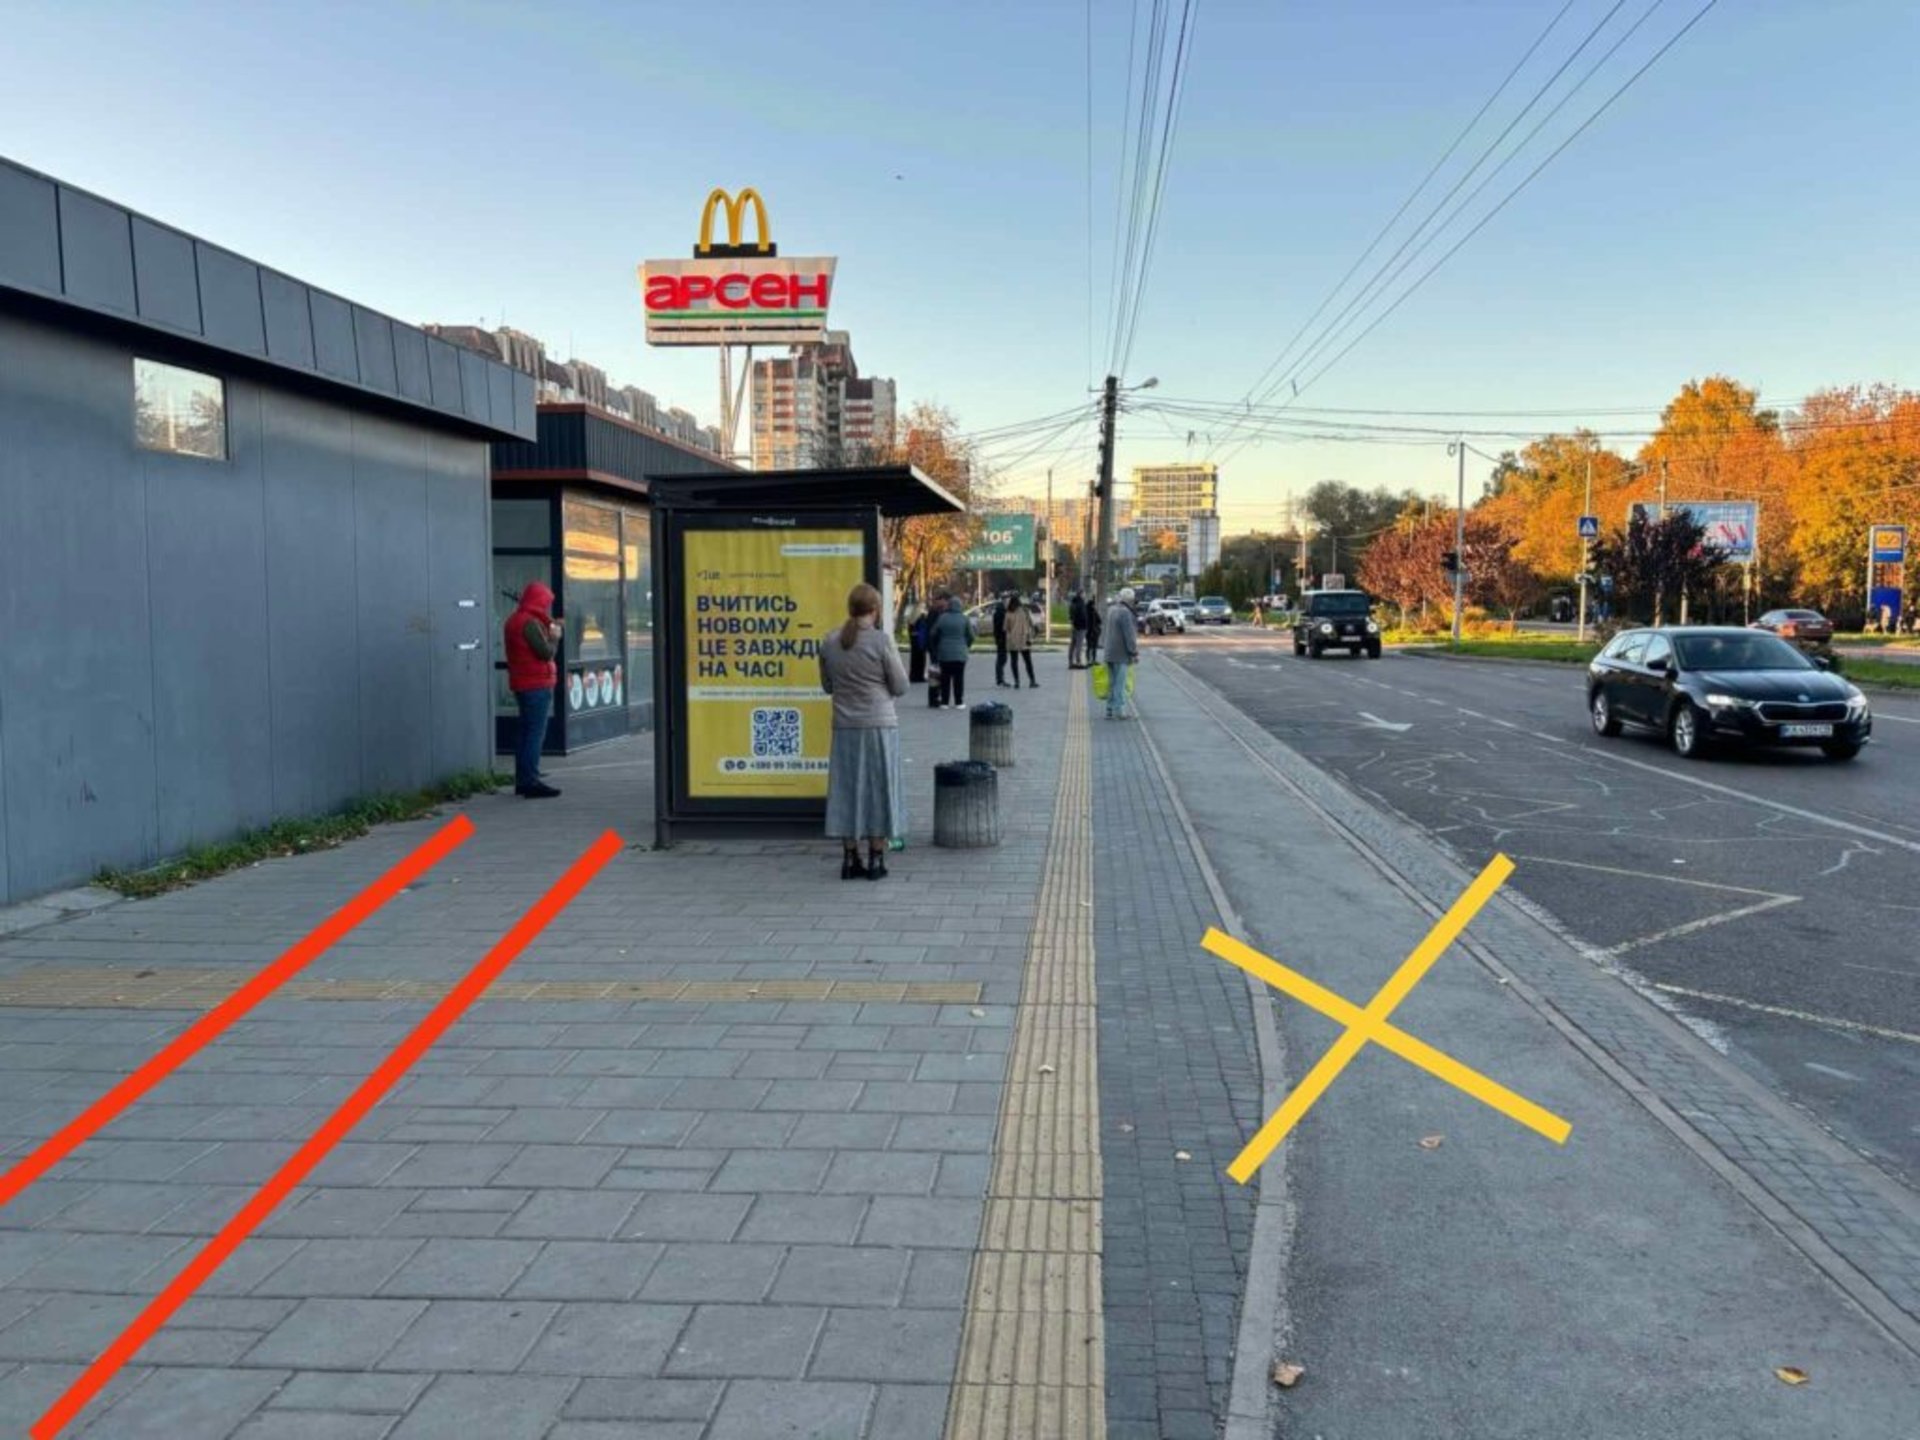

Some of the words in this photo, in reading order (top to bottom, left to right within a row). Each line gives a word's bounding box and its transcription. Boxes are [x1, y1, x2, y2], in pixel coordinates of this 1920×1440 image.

[697, 595, 797, 612] ВЧИТИСЬ
[697, 617, 790, 634] НОВОМУ
[698, 638, 728, 659] ЦЕ
[698, 660, 728, 678] НА
[734, 660, 784, 678] ЧАСІ
